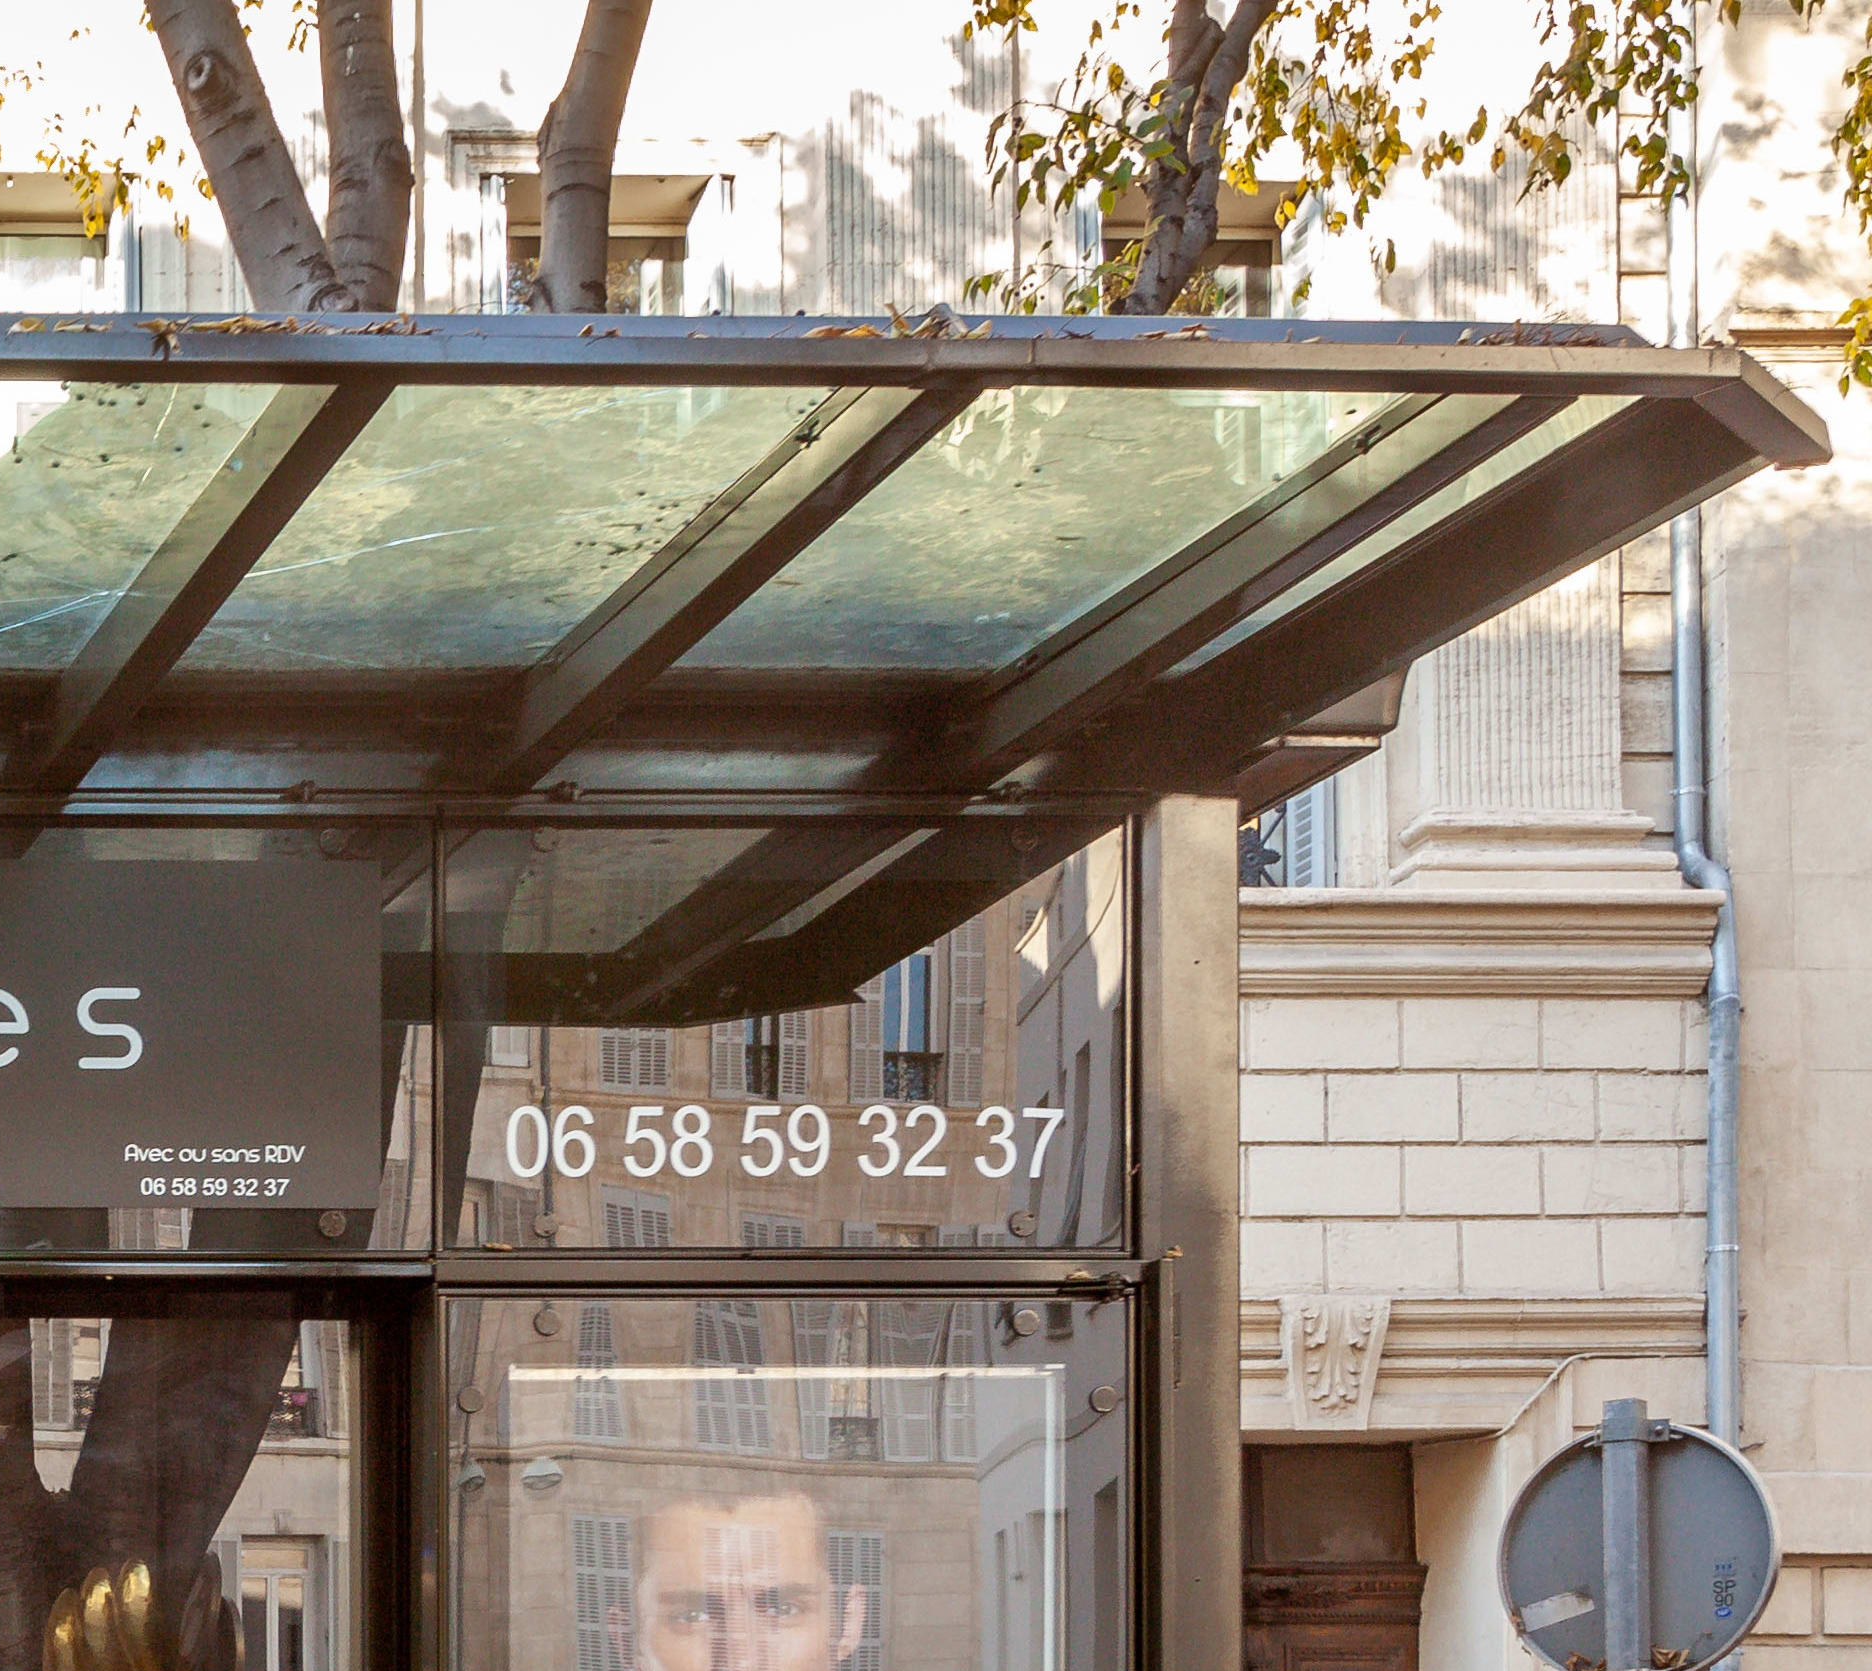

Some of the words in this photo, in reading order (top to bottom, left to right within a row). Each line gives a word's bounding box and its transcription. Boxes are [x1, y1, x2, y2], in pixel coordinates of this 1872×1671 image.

[506, 1105, 596, 1178] 06
[623, 1104, 714, 1178] 58
[740, 1104, 830, 1177] 59
[857, 1104, 947, 1177] 32
[974, 1105, 1065, 1178] 37
[124, 1143, 175, 1162] Avec
[178, 1148, 207, 1163] ou
[210, 1148, 261, 1163] sans
[265, 1144, 306, 1163] RDV
[140, 1177, 166, 1196] 06
[171, 1177, 197, 1196] 58
[202, 1177, 228, 1196] 59
[233, 1178, 258, 1197] 32
[263, 1178, 290, 1197] 37
[1712, 1580, 1736, 1593] SP
[1714, 1593, 1734, 1607] 90
